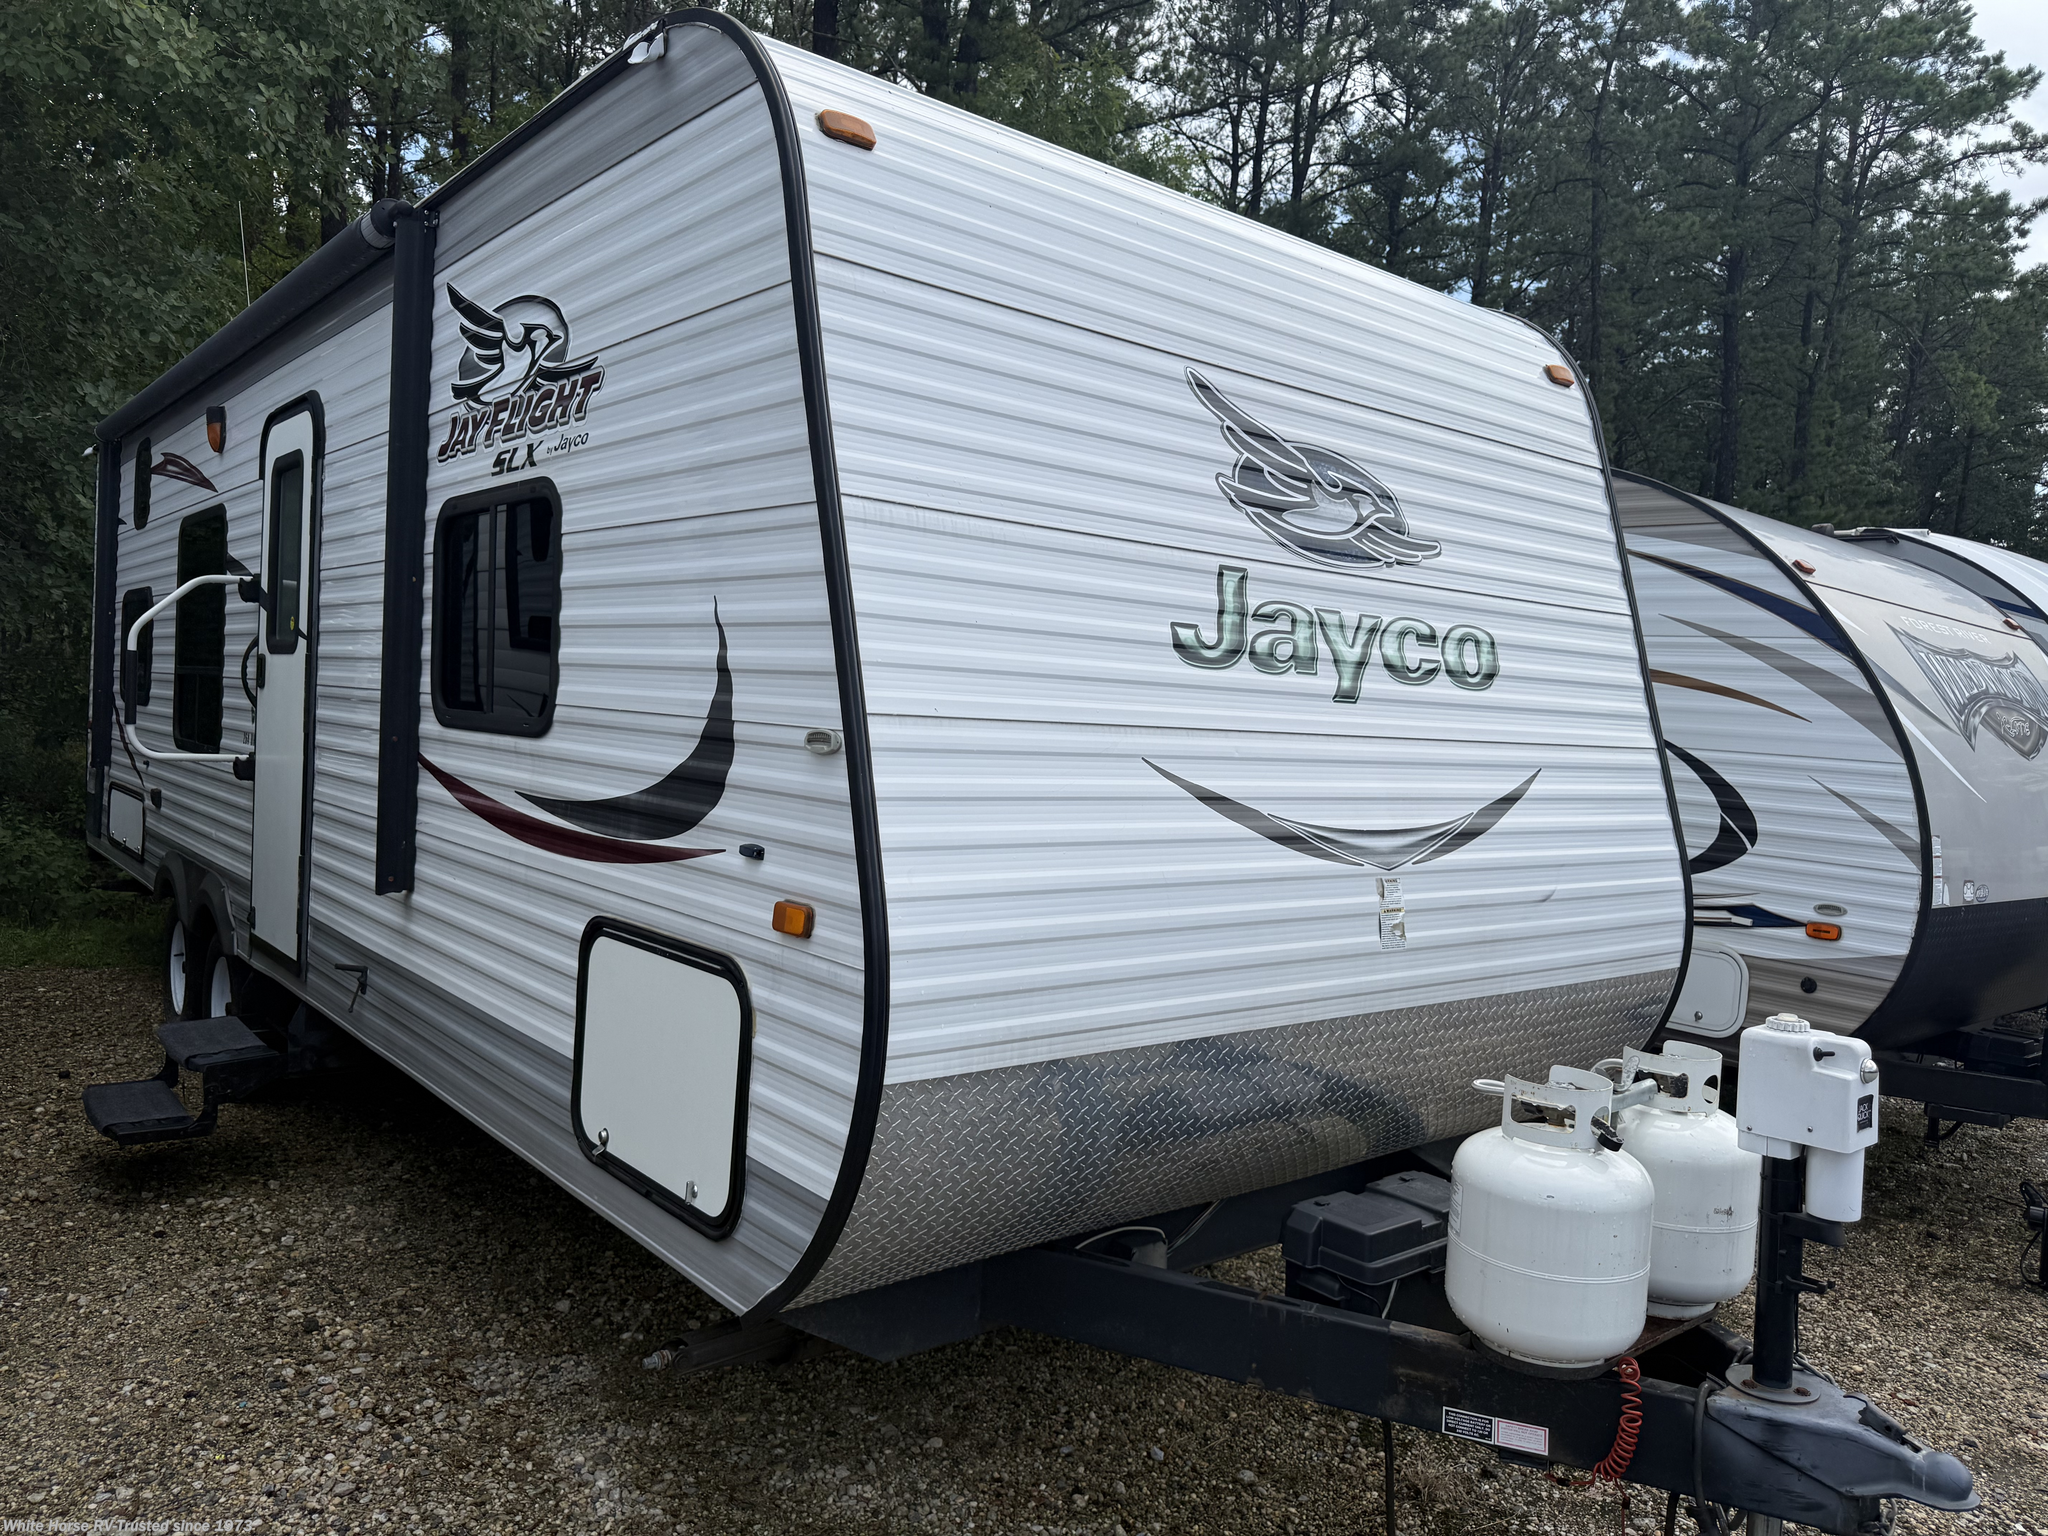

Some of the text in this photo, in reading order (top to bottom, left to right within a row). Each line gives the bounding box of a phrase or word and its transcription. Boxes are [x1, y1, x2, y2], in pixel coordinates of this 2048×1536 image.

[490, 440, 545, 477] SLX
[554, 433, 589, 453] Jayco
[1170, 564, 1500, 704] Jayco
[1900, 615, 1991, 645] FOREST RIVER
